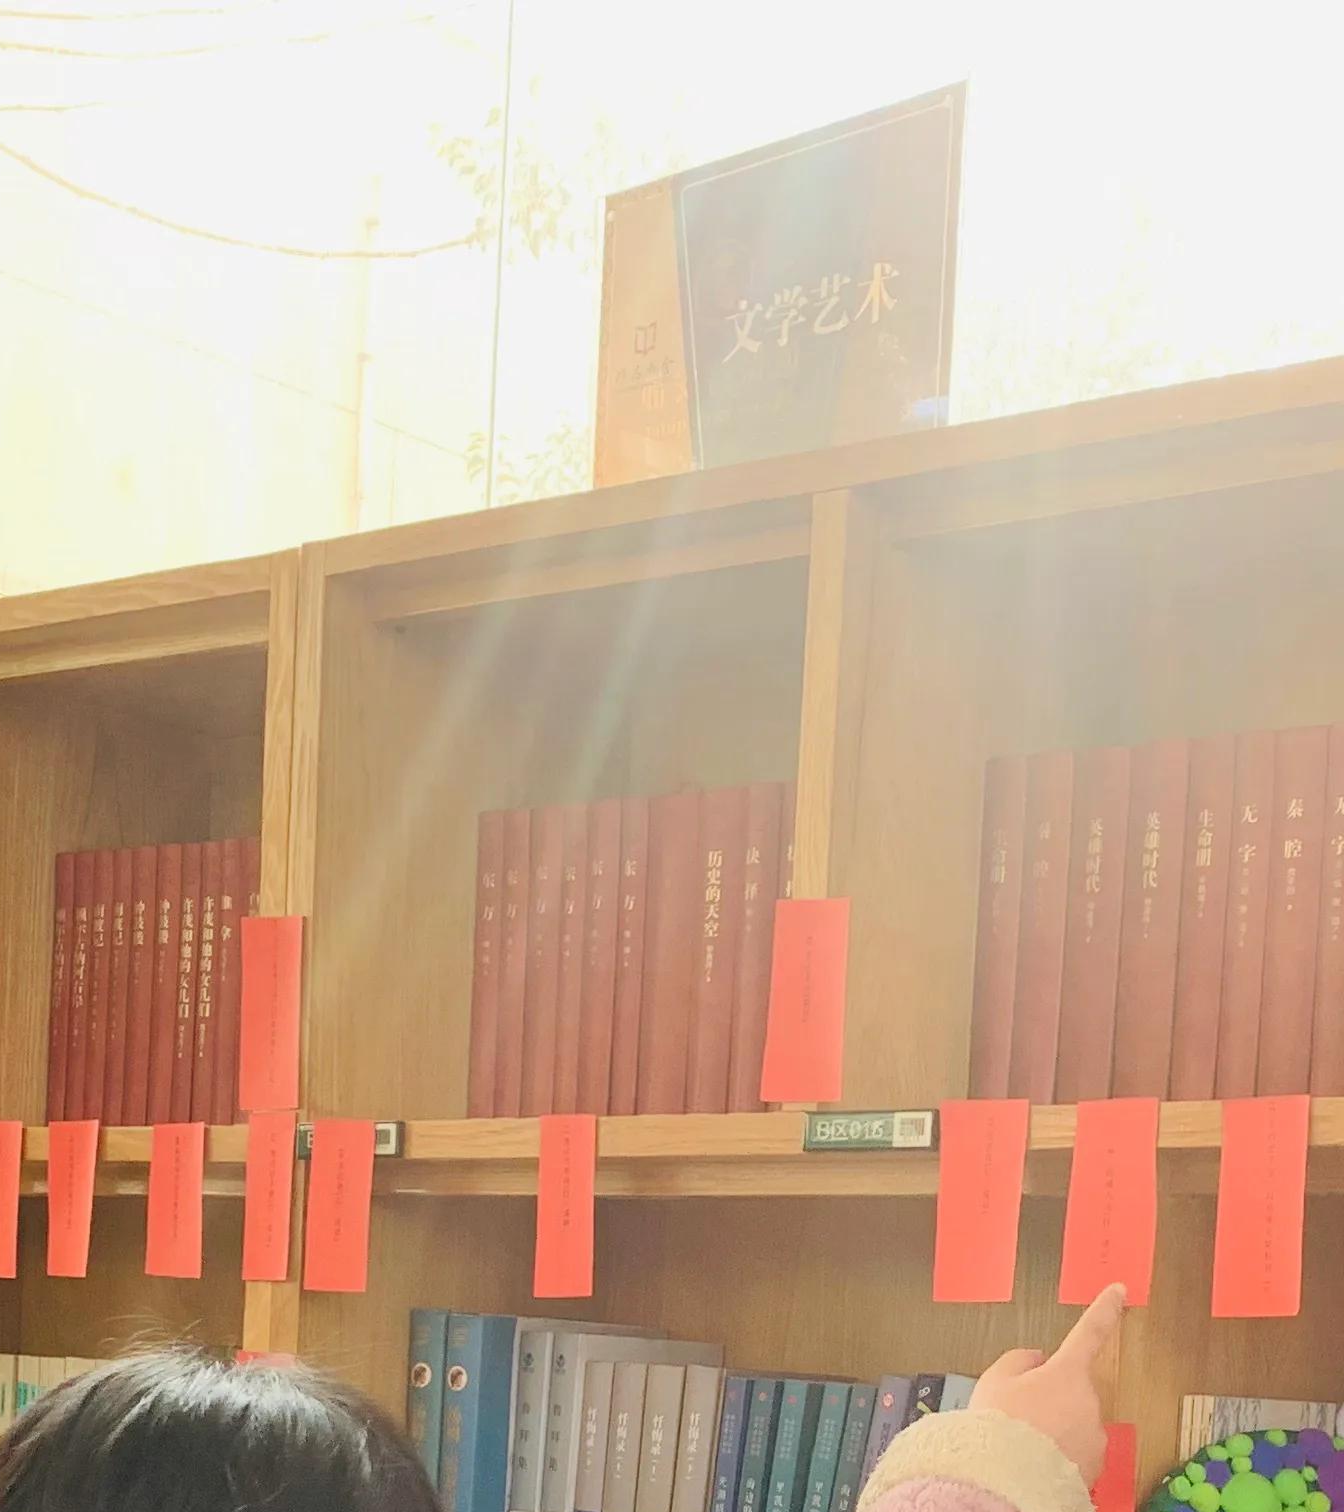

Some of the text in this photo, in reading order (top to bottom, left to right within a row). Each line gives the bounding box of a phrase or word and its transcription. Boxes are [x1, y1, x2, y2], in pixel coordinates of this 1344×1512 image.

[722, 261, 900, 364] 文学艺术
[1141, 809, 1162, 889] 英雄时代
[1237, 803, 1259, 864] 无字
[1284, 797, 1305, 859] 秦腔
[703, 850, 724, 938] 历史的天空
